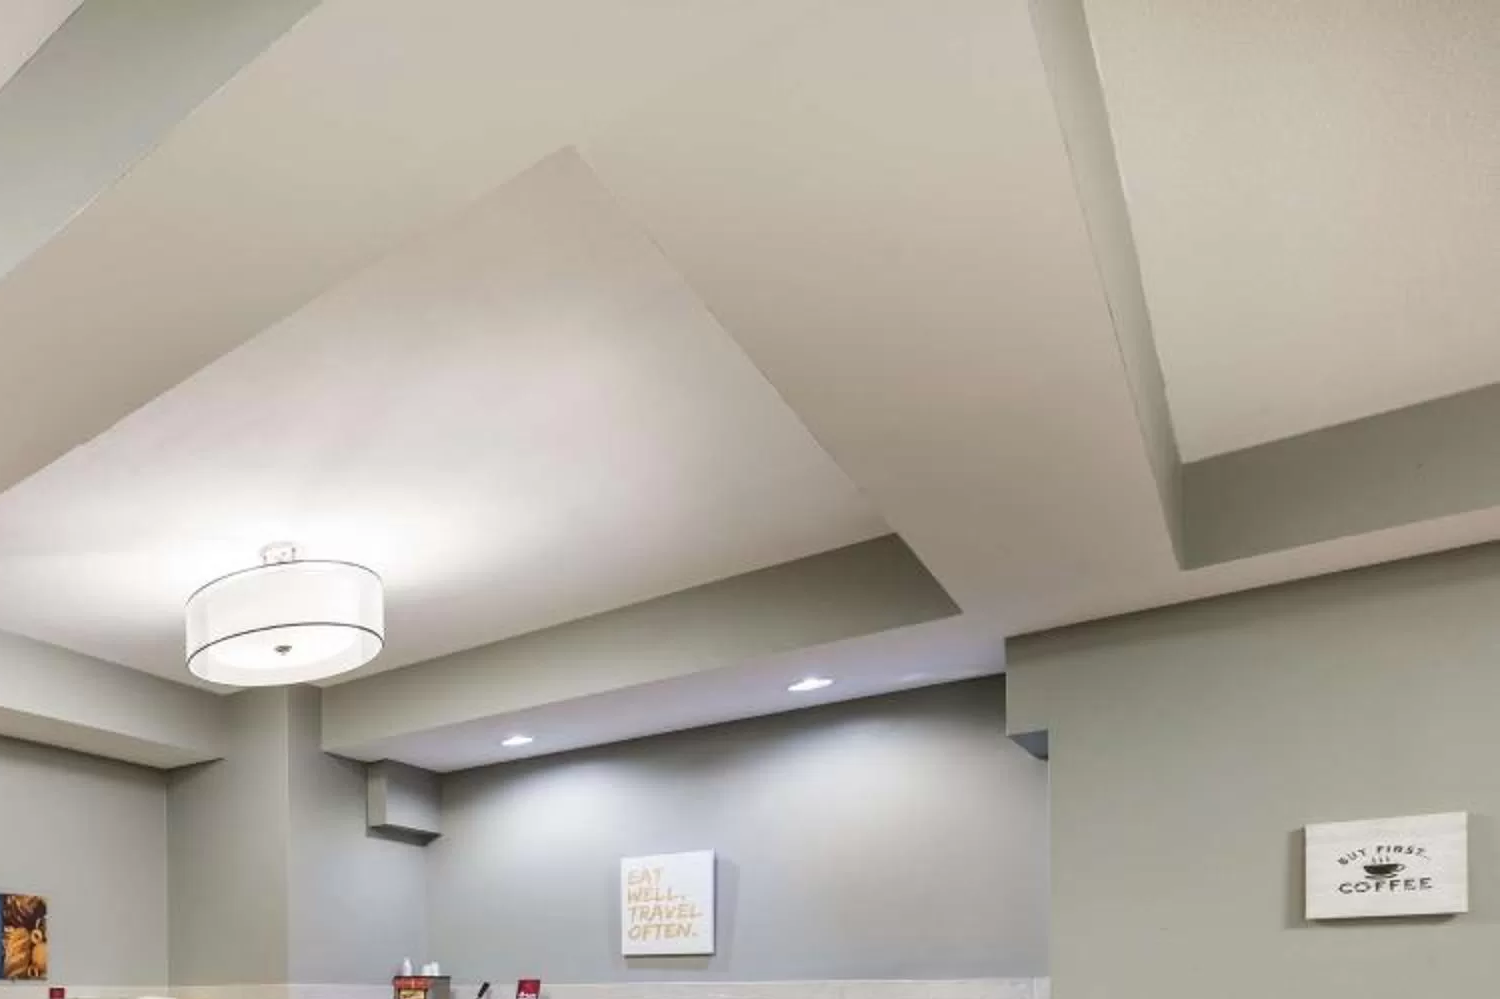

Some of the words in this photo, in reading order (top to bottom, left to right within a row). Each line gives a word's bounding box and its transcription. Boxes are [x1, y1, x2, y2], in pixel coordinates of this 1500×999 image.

[1337, 848, 1366, 866] BUT
[627, 867, 661, 885] EAT
[1338, 876, 1433, 895] COFFEE
[627, 903, 704, 924] TRAVEL
[627, 923, 699, 941] OFTEN.
